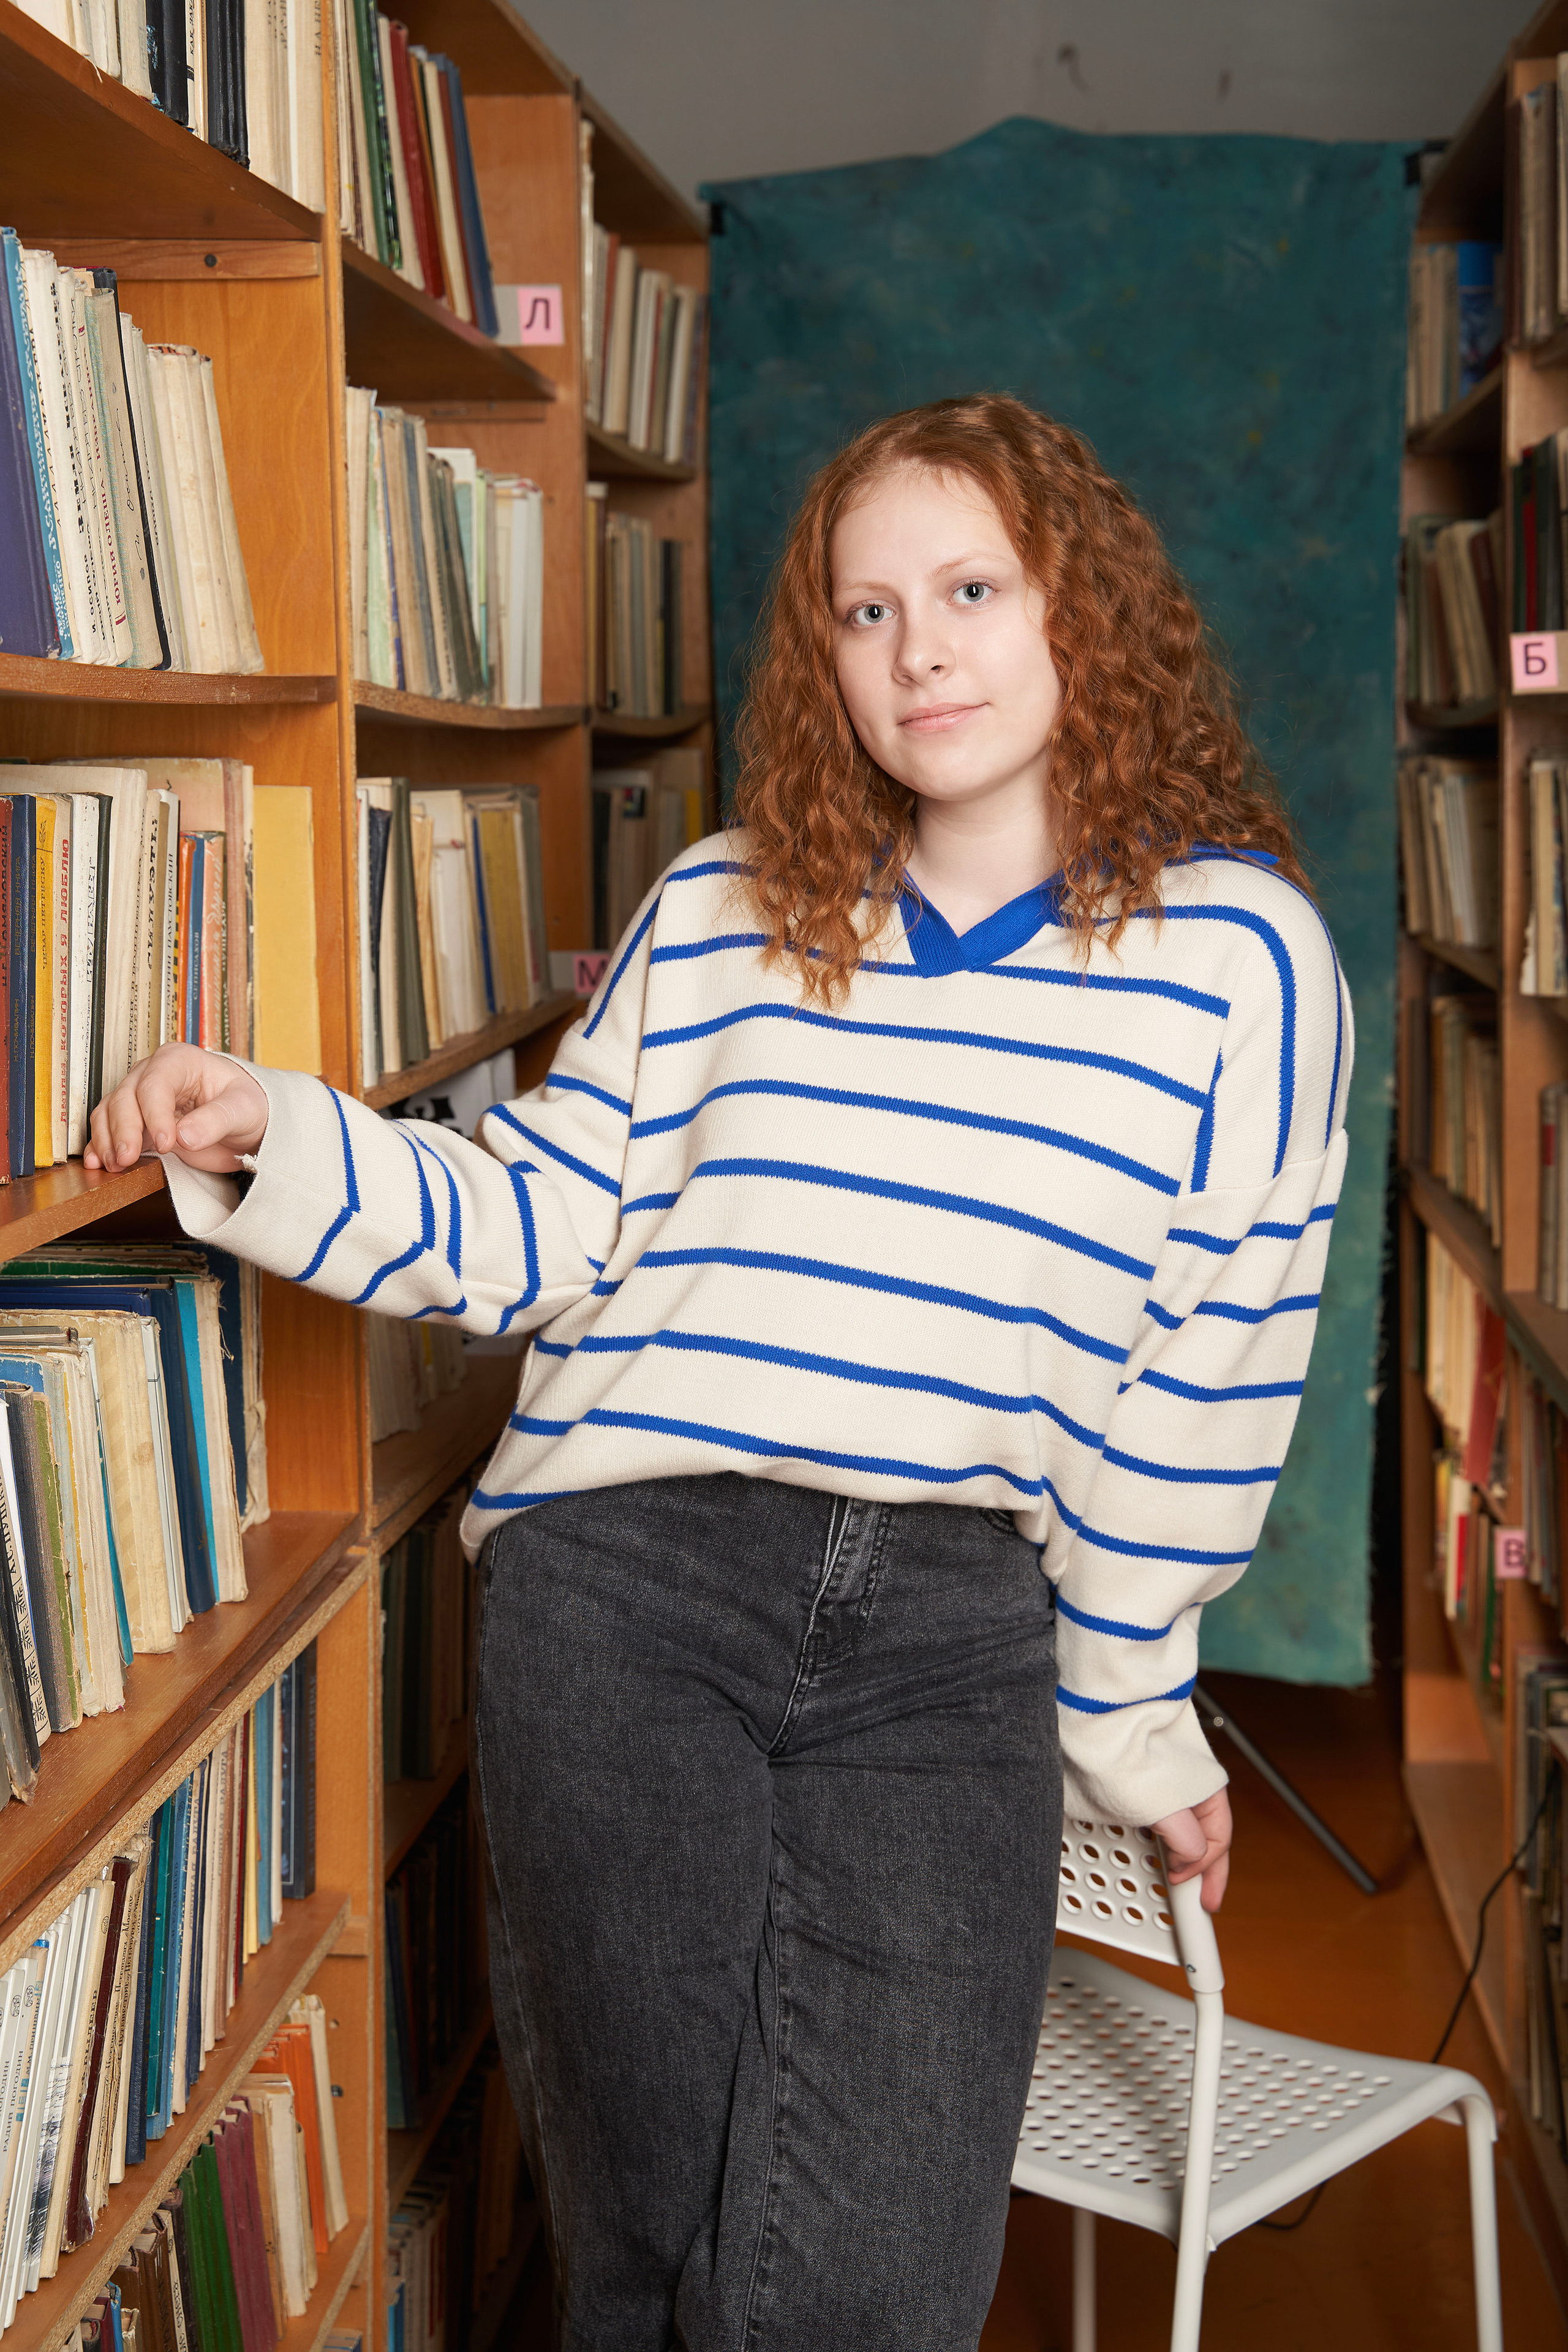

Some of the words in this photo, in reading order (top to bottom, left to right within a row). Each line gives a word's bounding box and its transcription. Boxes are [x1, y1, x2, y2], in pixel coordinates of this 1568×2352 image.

[525, 298, 551, 331] Л
[69, 445, 84, 533] ЗЕМЛЯ
[100, 477, 113, 546] ОЛЕША
[84, 554, 94, 616] ОСИПОВ
[109, 551, 121, 606] ЮРИЙ
[53, 584, 64, 636] ФЕЛИКС
[95, 591, 105, 641] ЮРИЙ
[1523, 643, 1547, 677] Б
[147, 820, 158, 970] СИЛУЭТЫ
[61, 934, 67, 946] Я
[579, 960, 606, 989] М
[1504, 1539, 1525, 1567] В
[3, 2111, 13, 2153] РАДИЙ
[10, 2049, 23, 2106] ПОГОДИН
